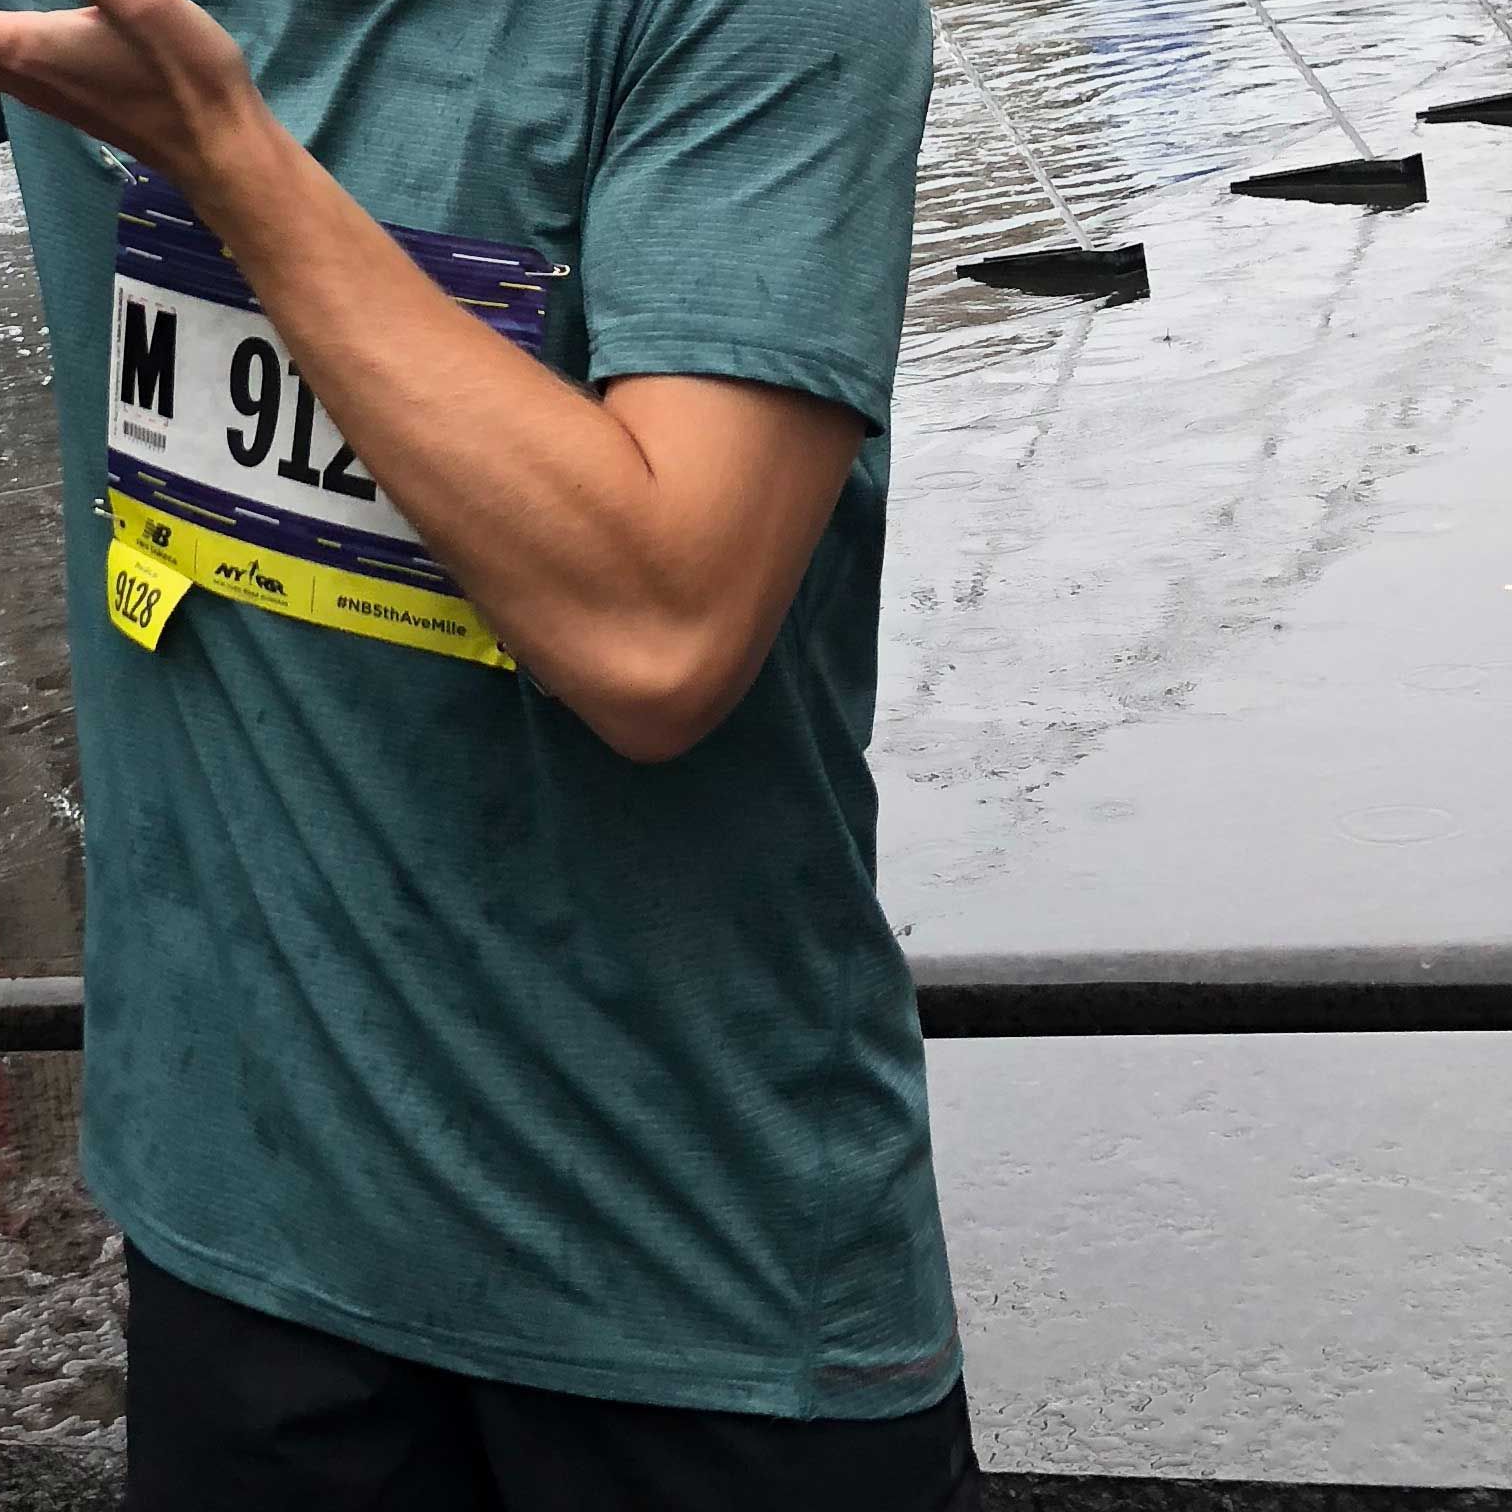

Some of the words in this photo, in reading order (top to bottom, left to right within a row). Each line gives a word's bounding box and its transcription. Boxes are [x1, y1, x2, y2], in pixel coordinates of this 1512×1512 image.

[121, 300, 177, 419] M
[114, 571, 162, 628] 9128
[337, 595, 467, 637] #NB5thAveMile
